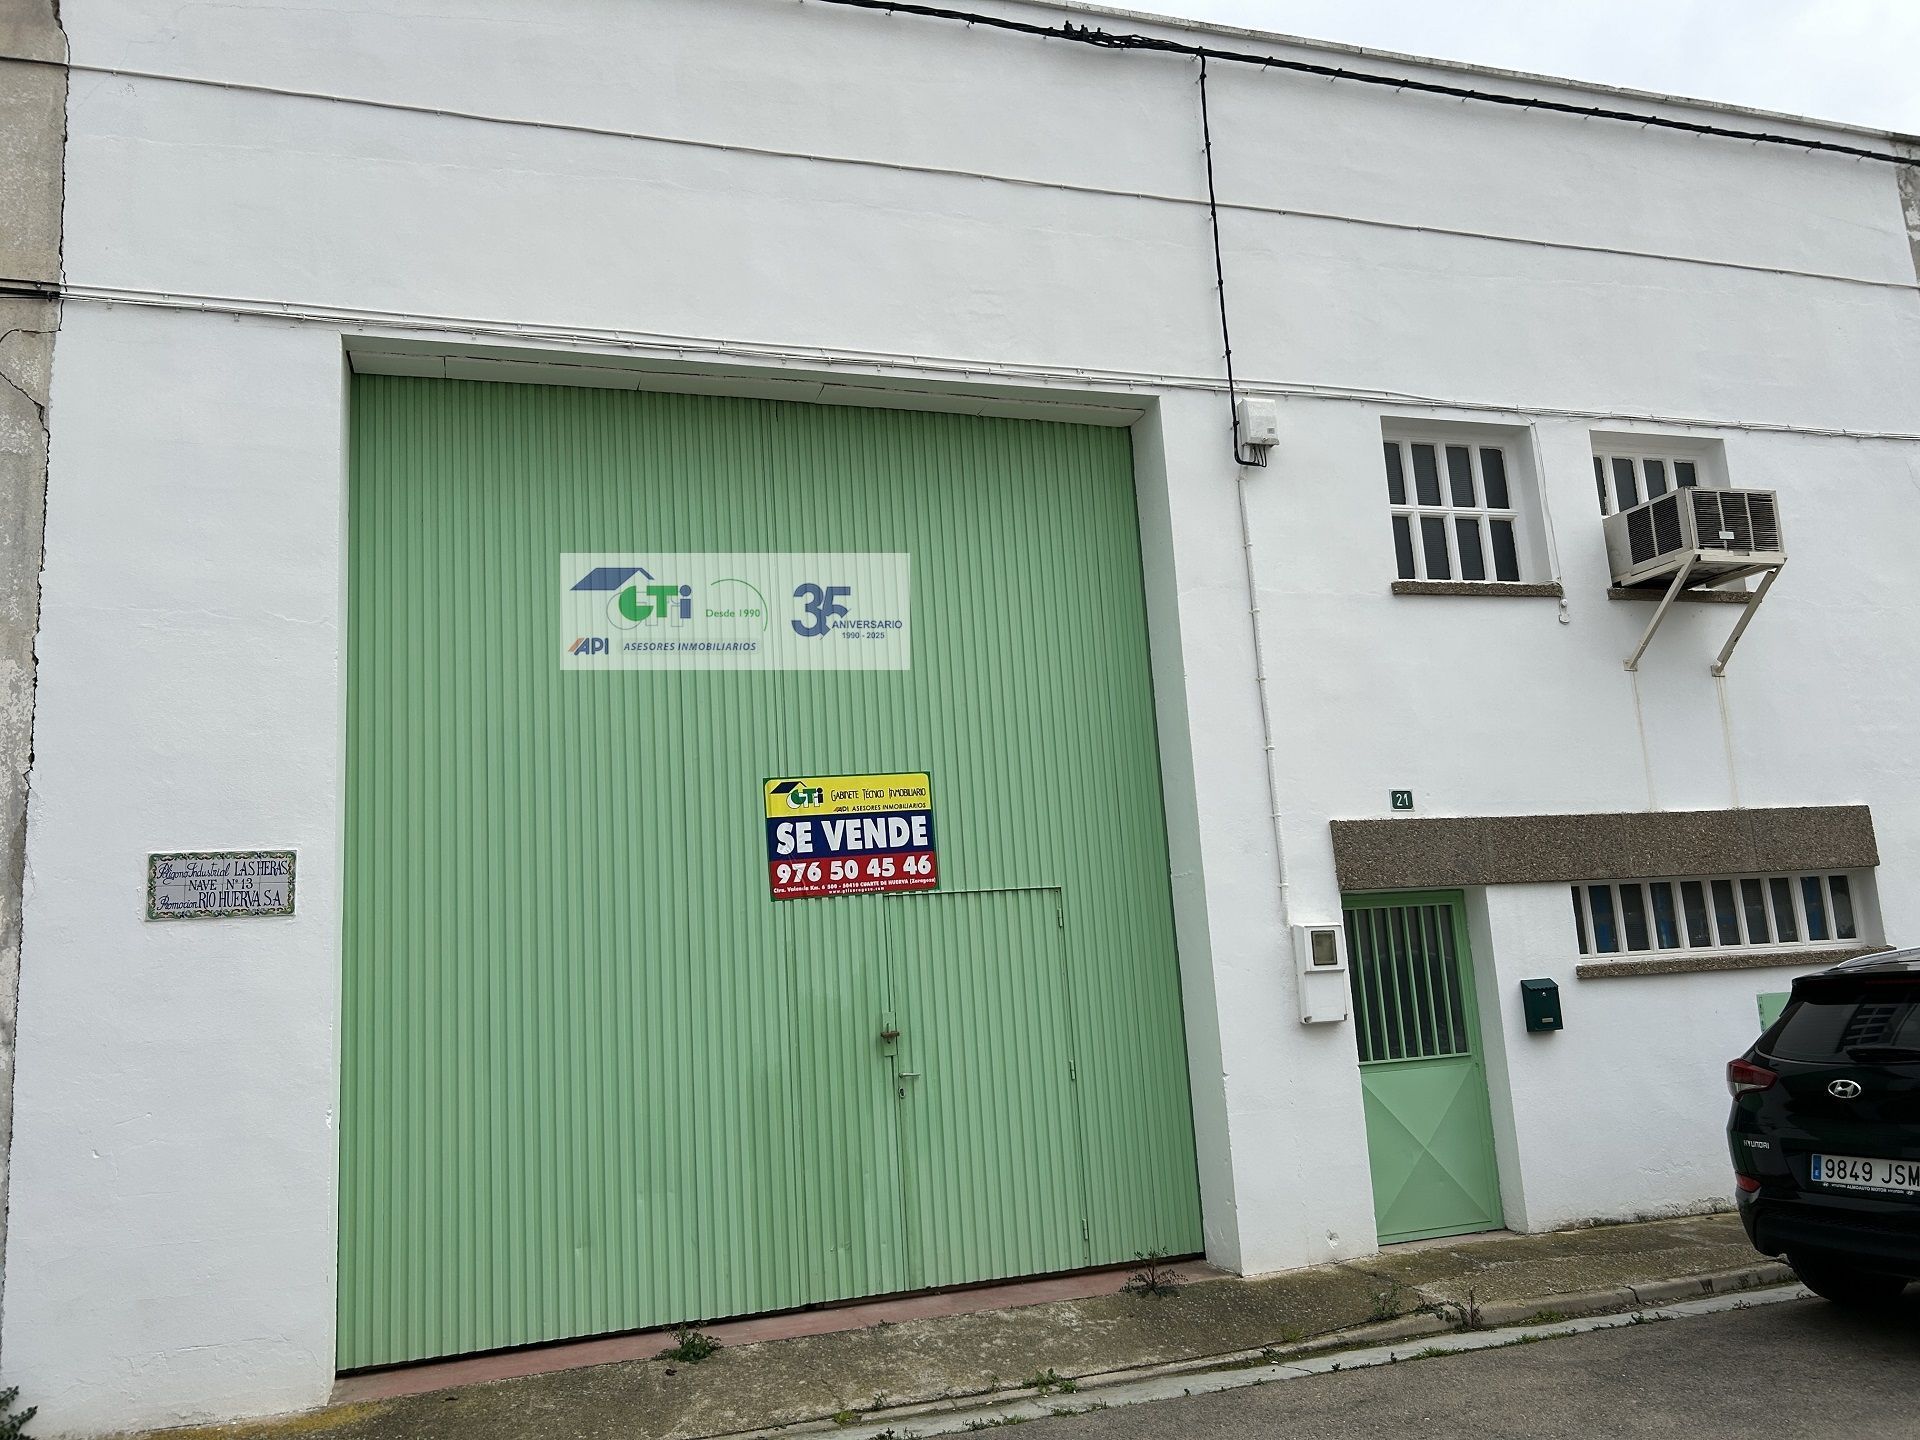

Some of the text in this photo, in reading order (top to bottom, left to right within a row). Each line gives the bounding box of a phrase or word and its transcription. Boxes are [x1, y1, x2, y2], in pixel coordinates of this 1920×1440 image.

[830, 789, 859, 802] GABINETE
[888, 787, 926, 799] INMOBILIARIO
[1396, 793, 1409, 806] 21
[851, 804, 881, 812] ASESORES
[882, 802, 926, 810] INMOBILIARIOS
[776, 815, 929, 855] SE VENDE
[185, 862, 230, 877] Industrial
[234, 861, 255, 877] LAS
[256, 860, 288, 877] HERAS
[776, 854, 932, 884] 976 50 45 46
[188, 879, 217, 892] NAVE
[241, 878, 254, 890] 13
[860, 880, 880, 888] CUARTE
[887, 878, 909, 886] HUERVA
[198, 890, 217, 909] RIO
[218, 890, 261, 909] HUERVA
[1743, 1139, 1770, 1150] HYUNDAI
[1825, 1158, 1920, 1187] 9849 JSM
